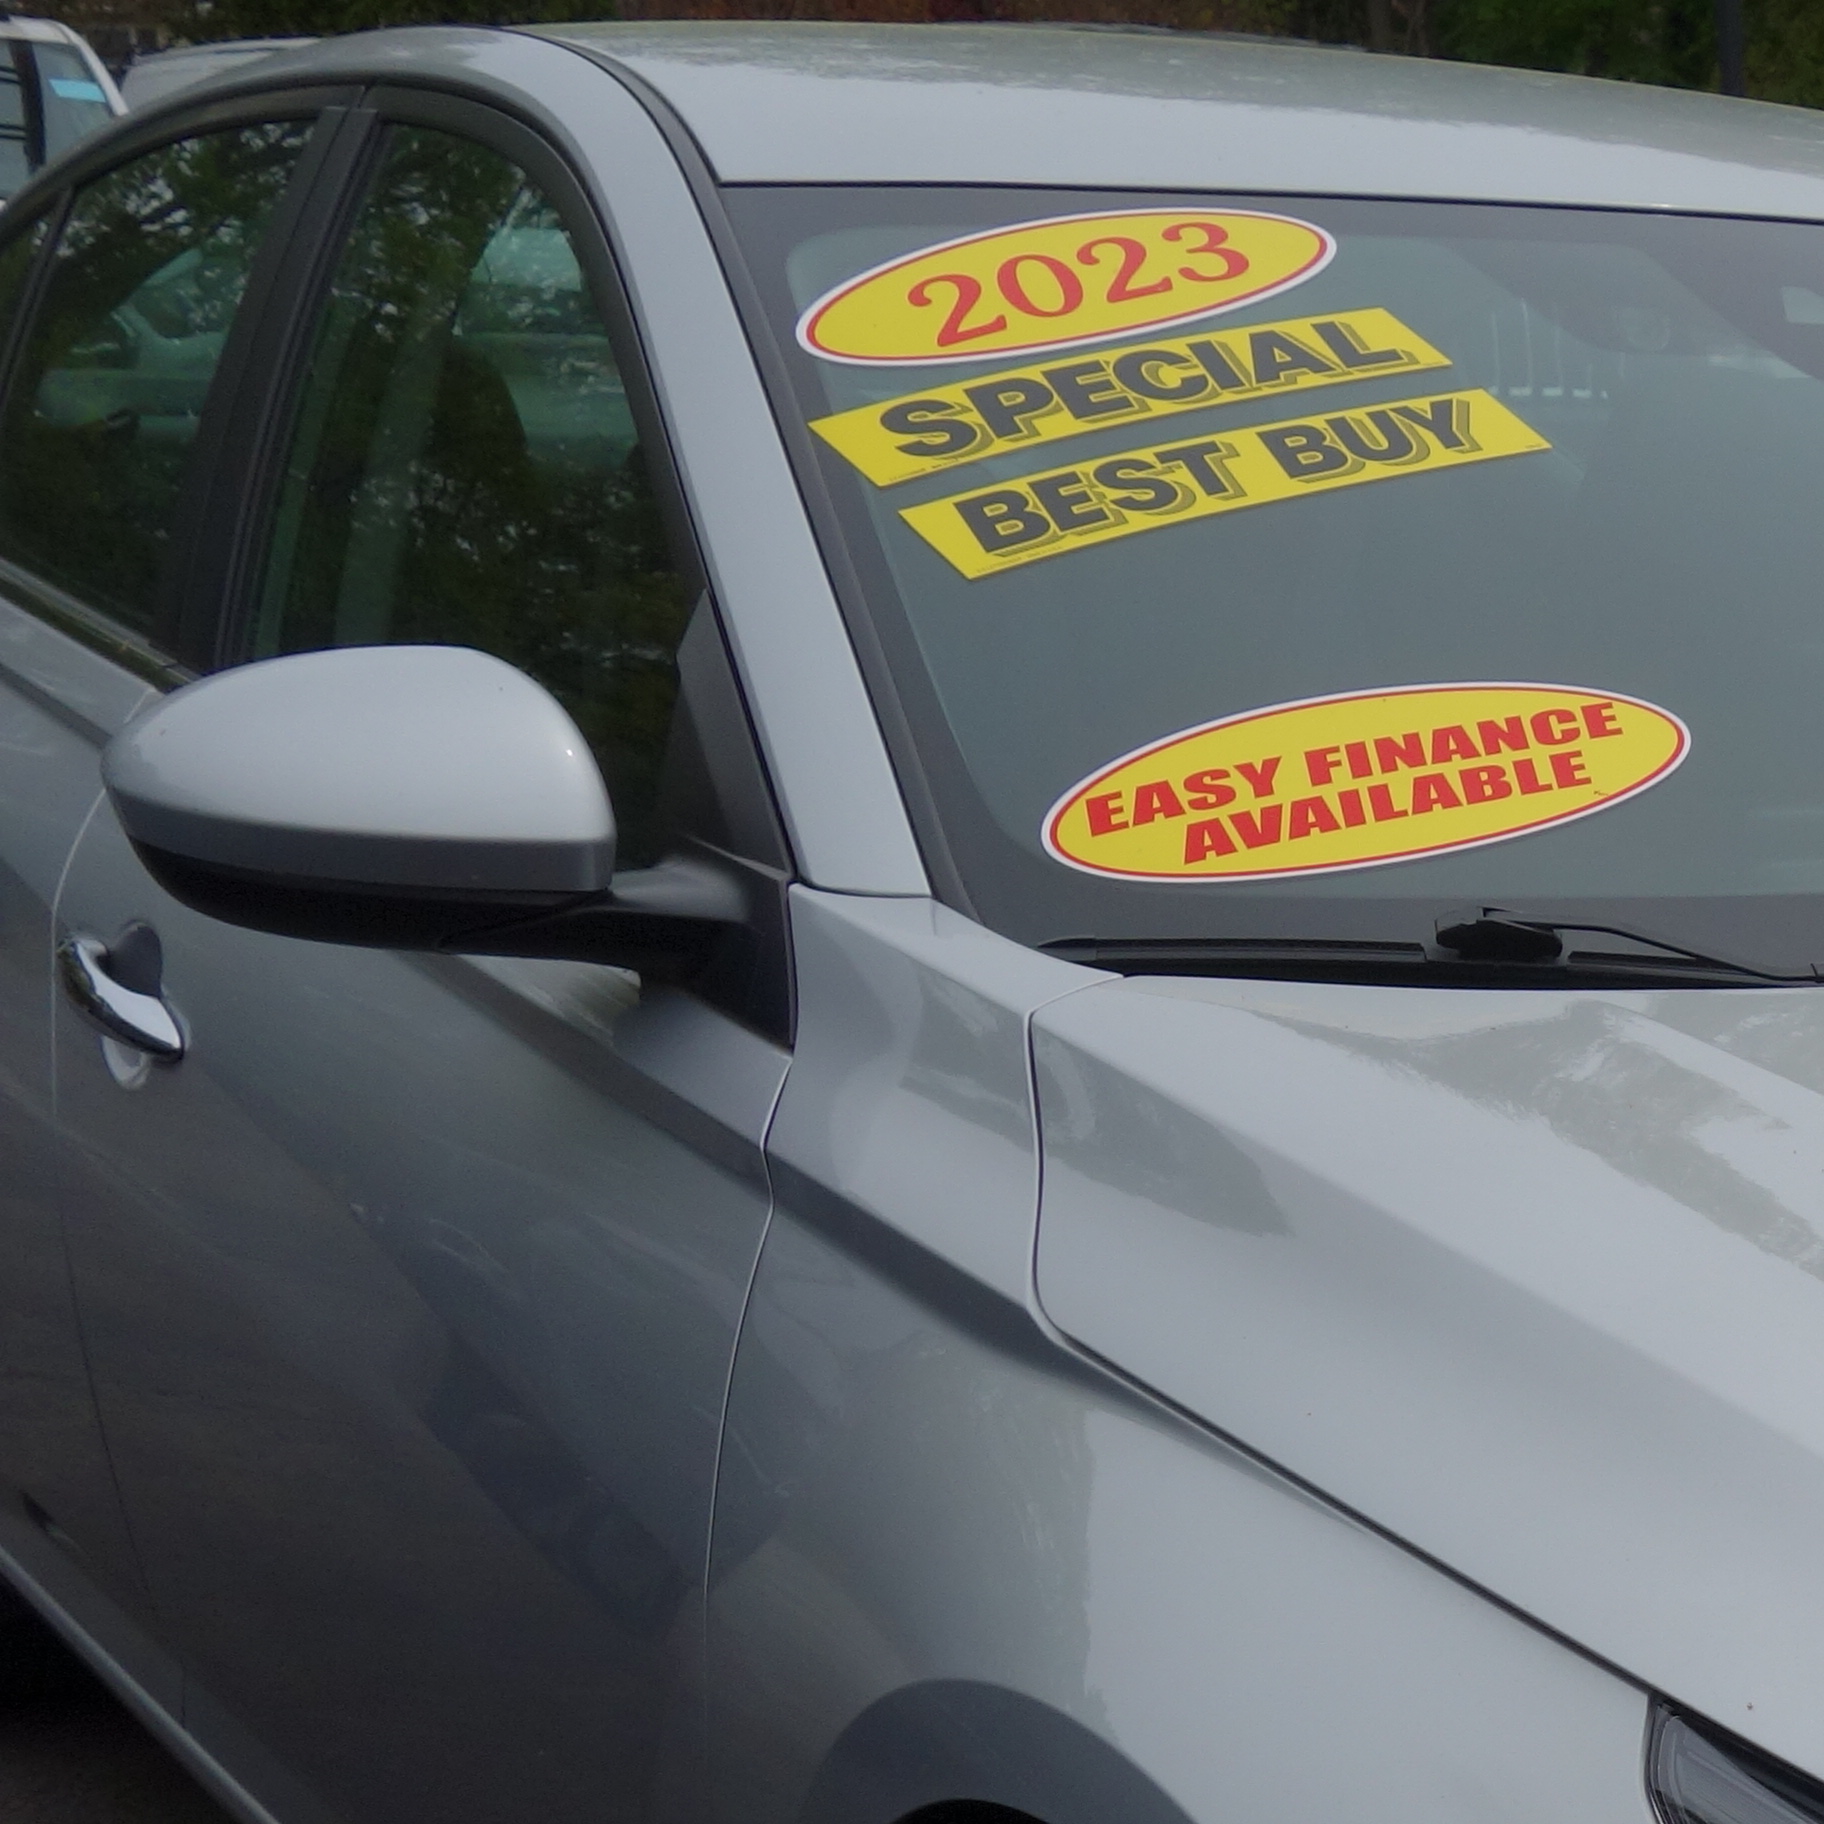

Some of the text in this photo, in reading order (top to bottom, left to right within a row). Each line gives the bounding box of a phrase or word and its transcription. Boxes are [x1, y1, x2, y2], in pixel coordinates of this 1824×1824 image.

[906, 221, 1250, 348] 2023
[880, 319, 1408, 461] SPECIAL
[953, 398, 1485, 557] BEST BUY
[1083, 701, 1624, 839] EASY FINANCE
[1182, 749, 1592, 865] AVAILABLE
